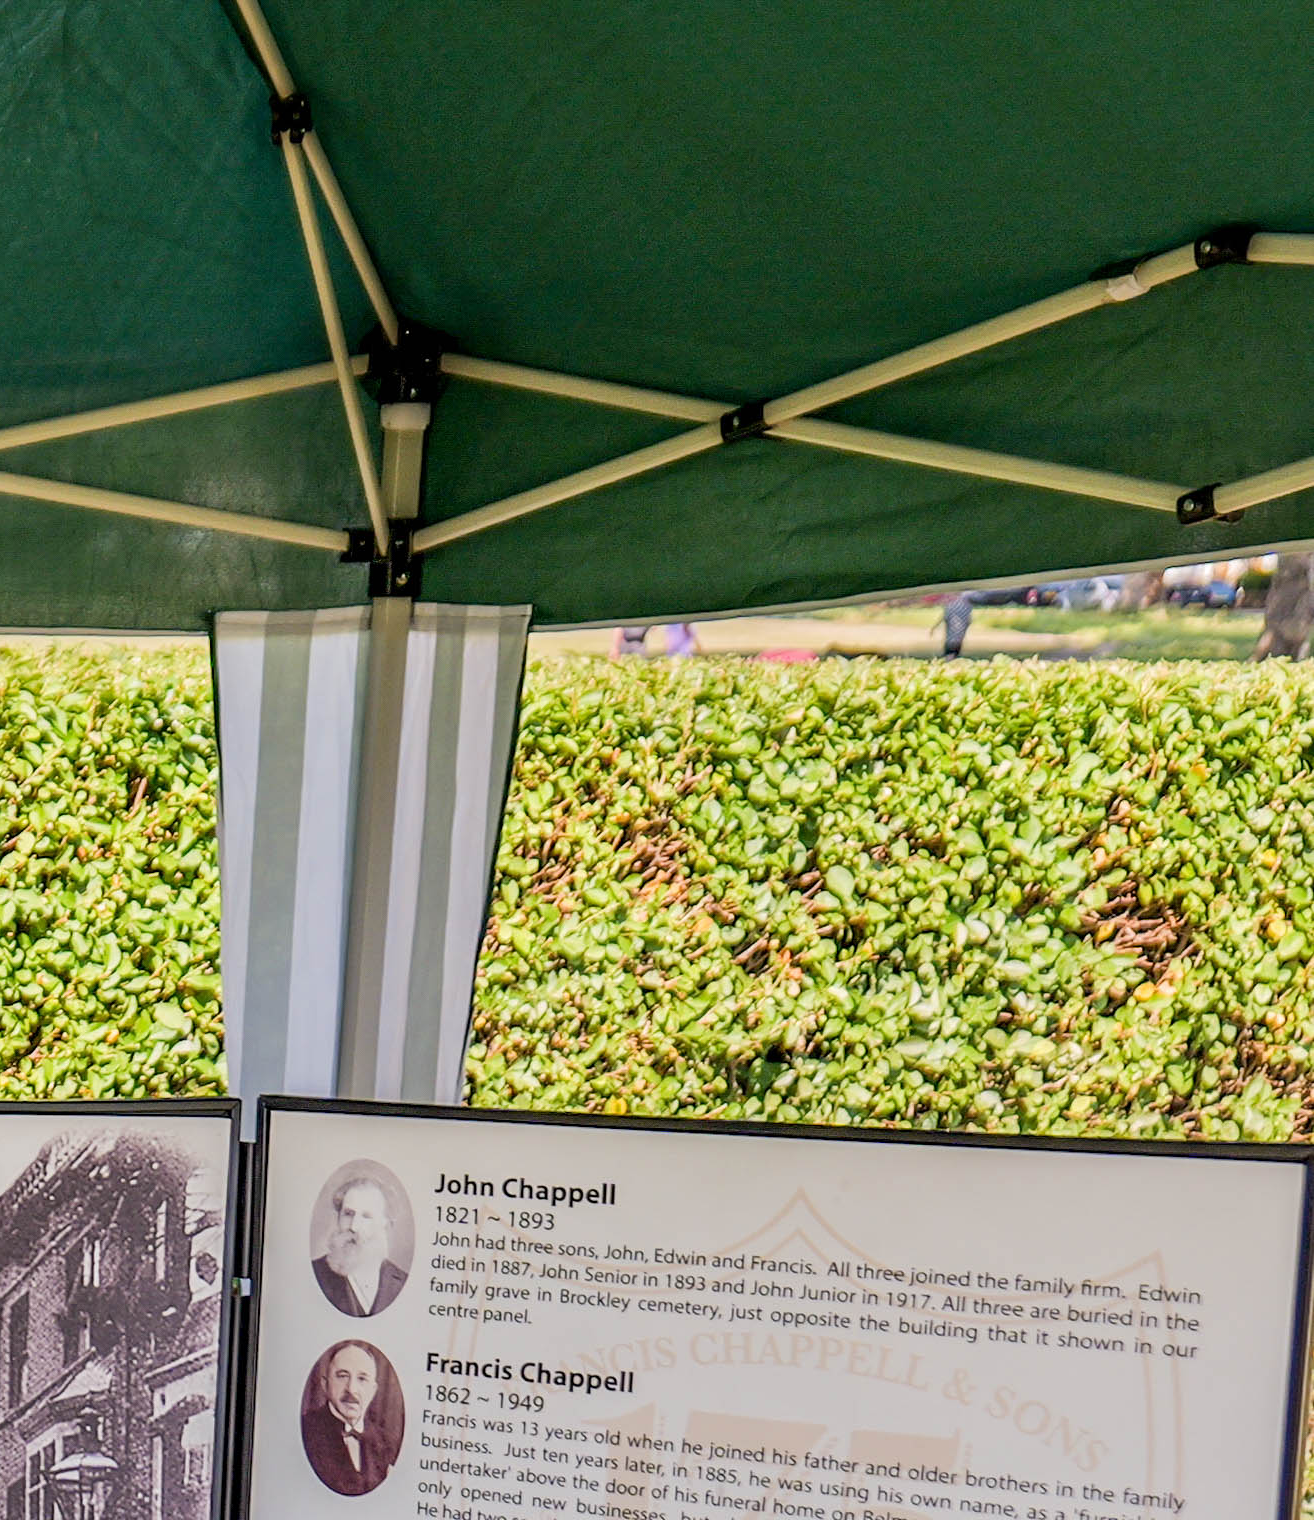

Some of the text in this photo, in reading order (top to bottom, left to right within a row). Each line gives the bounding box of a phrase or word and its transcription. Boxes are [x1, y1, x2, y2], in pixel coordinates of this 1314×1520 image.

[434, 1174, 615, 1208] John Chappell
[437, 1206, 478, 1225] 1821
[509, 1211, 555, 1231] 1893
[432, 1231, 1201, 1304] John had three sons, John, Edwin and Francis. All three joined the family firm. Edwin
[427, 1352, 633, 1395] Francis Chappell
[426, 1384, 471, 1405] 1862
[498, 1392, 544, 1413] 1949
